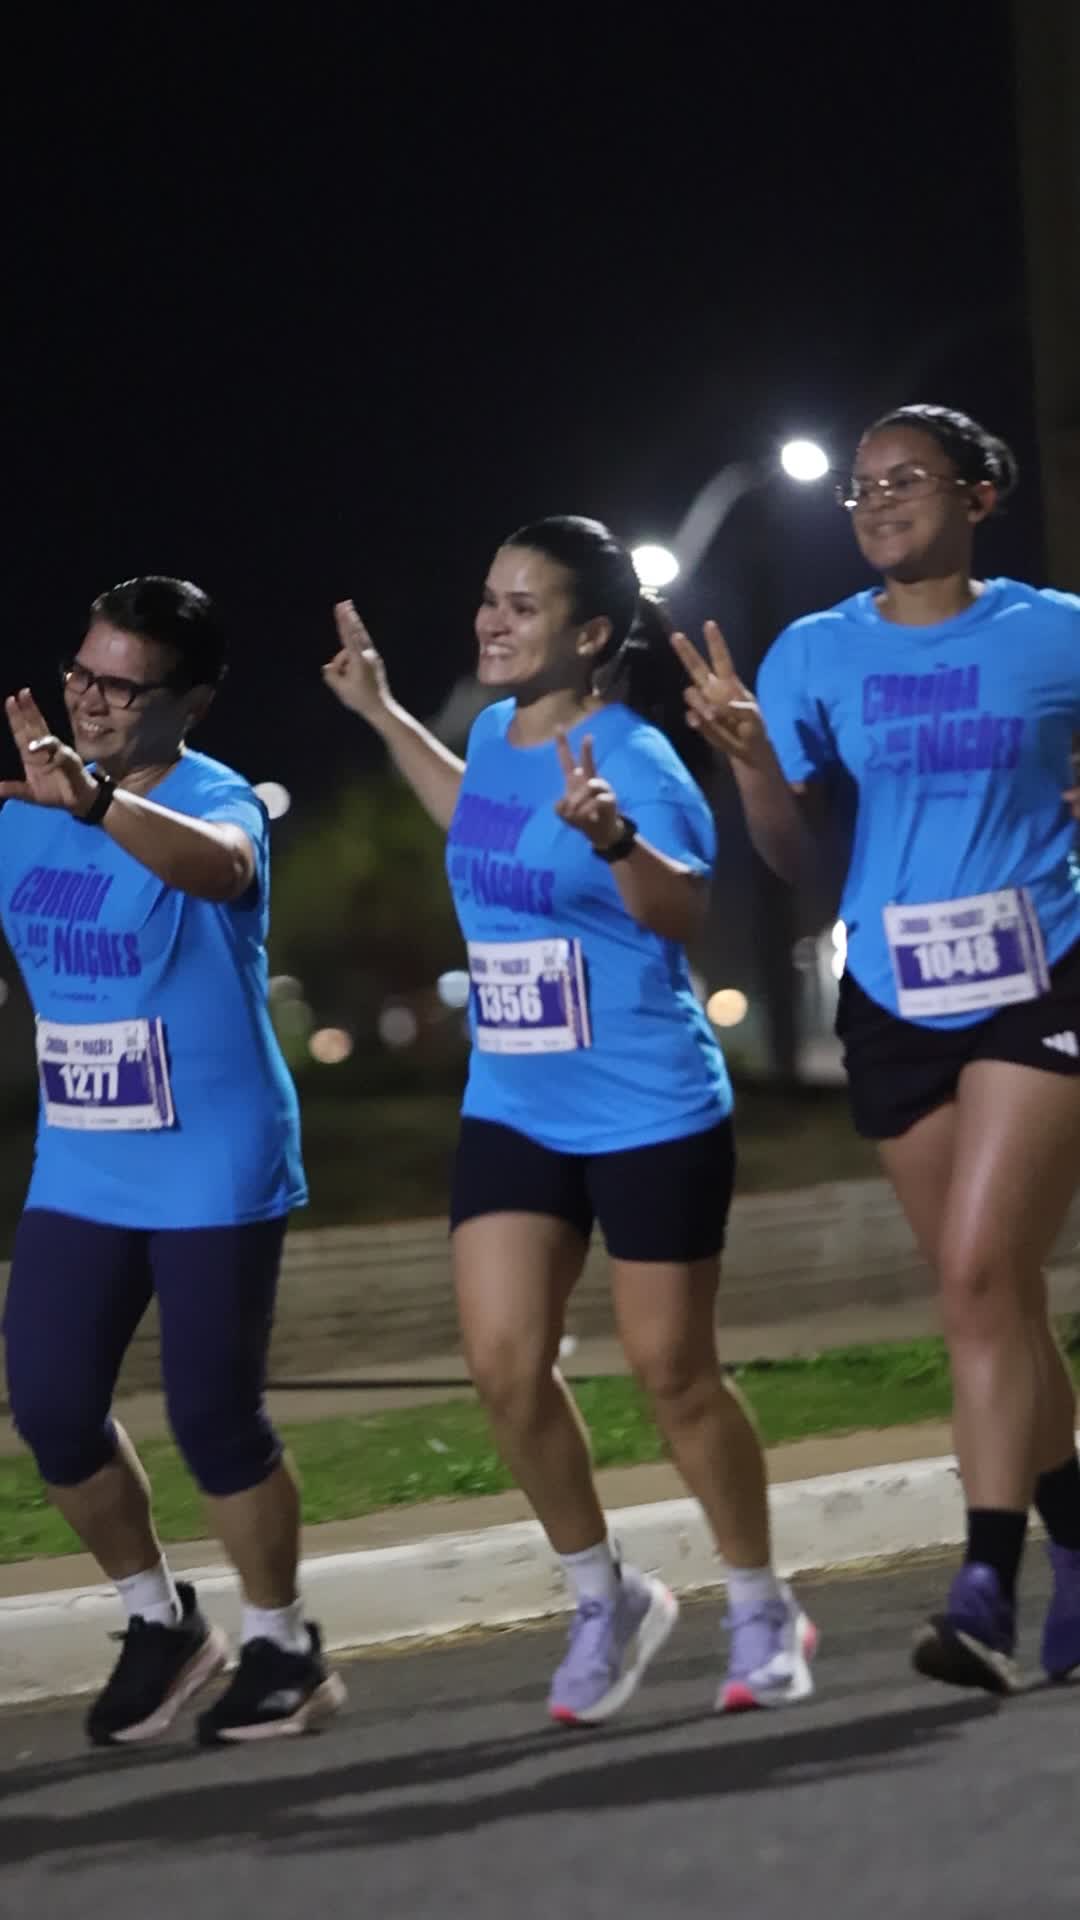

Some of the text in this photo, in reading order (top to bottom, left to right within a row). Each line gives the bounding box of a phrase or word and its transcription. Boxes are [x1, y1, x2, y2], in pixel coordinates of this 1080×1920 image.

[53, 921, 142, 985] NAÇÕES
[912, 933, 1000, 982] 1048
[477, 983, 543, 1023] 1356
[58, 1063, 119, 1101] 1277
